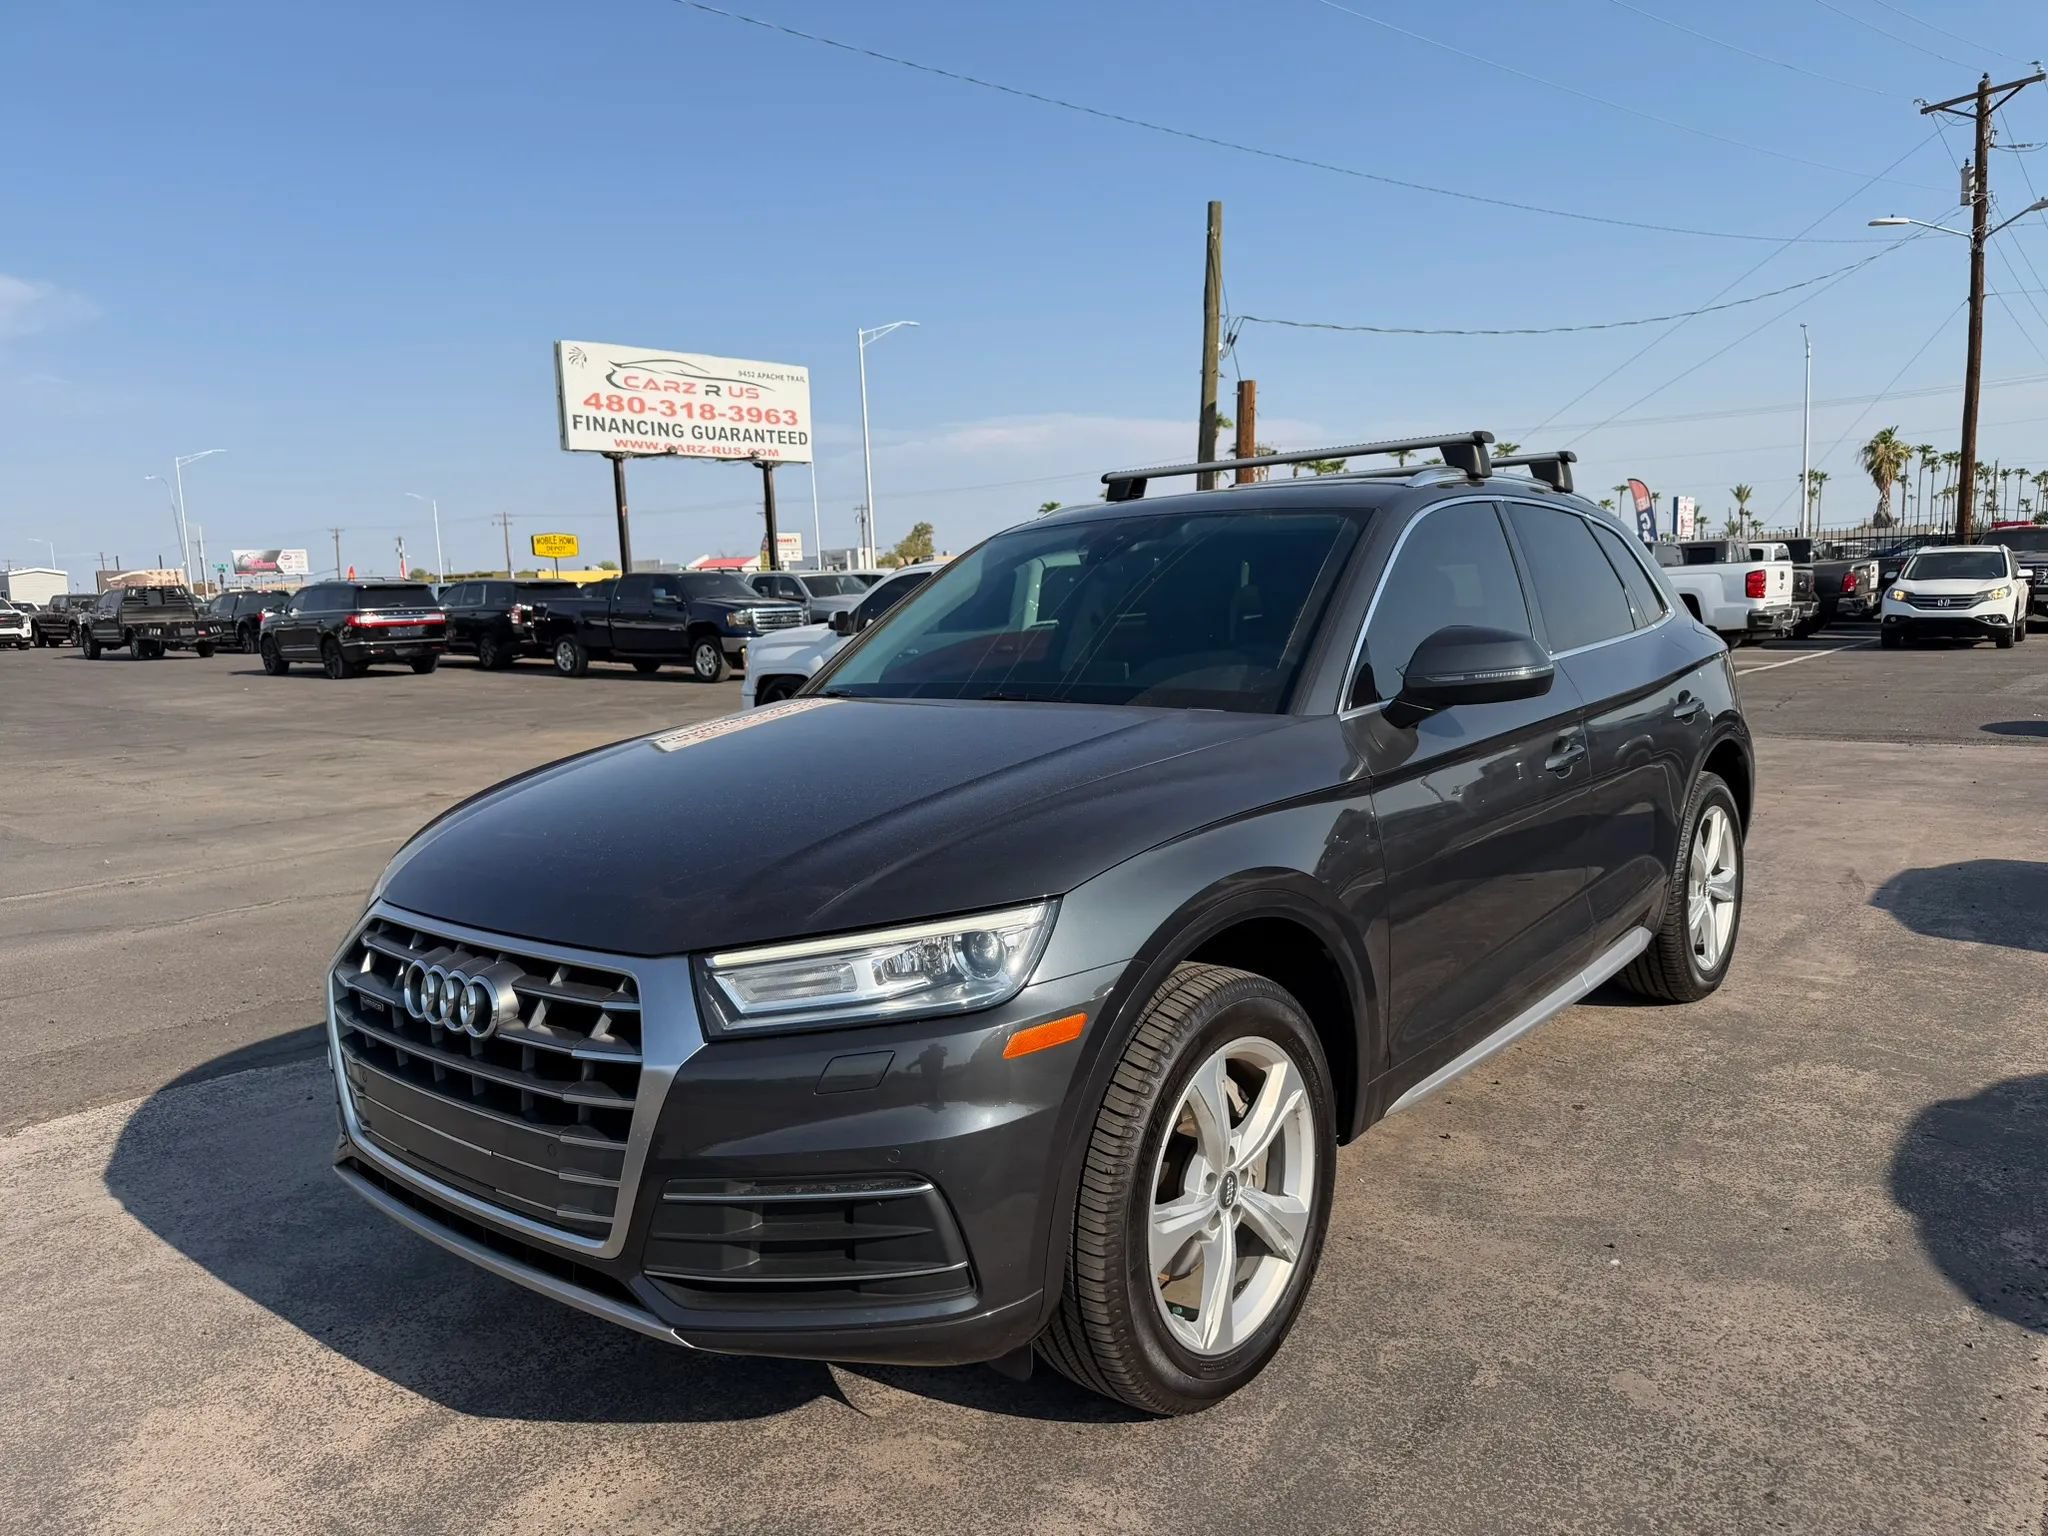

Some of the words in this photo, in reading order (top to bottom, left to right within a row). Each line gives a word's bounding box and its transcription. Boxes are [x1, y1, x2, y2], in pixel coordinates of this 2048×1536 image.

[623, 375, 696, 394] CARZ
[705, 384, 721, 397] R
[728, 385, 760, 399] US
[738, 370, 755, 378] 9452
[757, 372, 784, 381] APACHE
[786, 375, 806, 383] TRAIL
[583, 392, 798, 426] 480-318-3963
[572, 414, 684, 438] FINANCING
[691, 425, 808, 445] GUARANTEED
[536, 535, 558, 544] MOBILE
